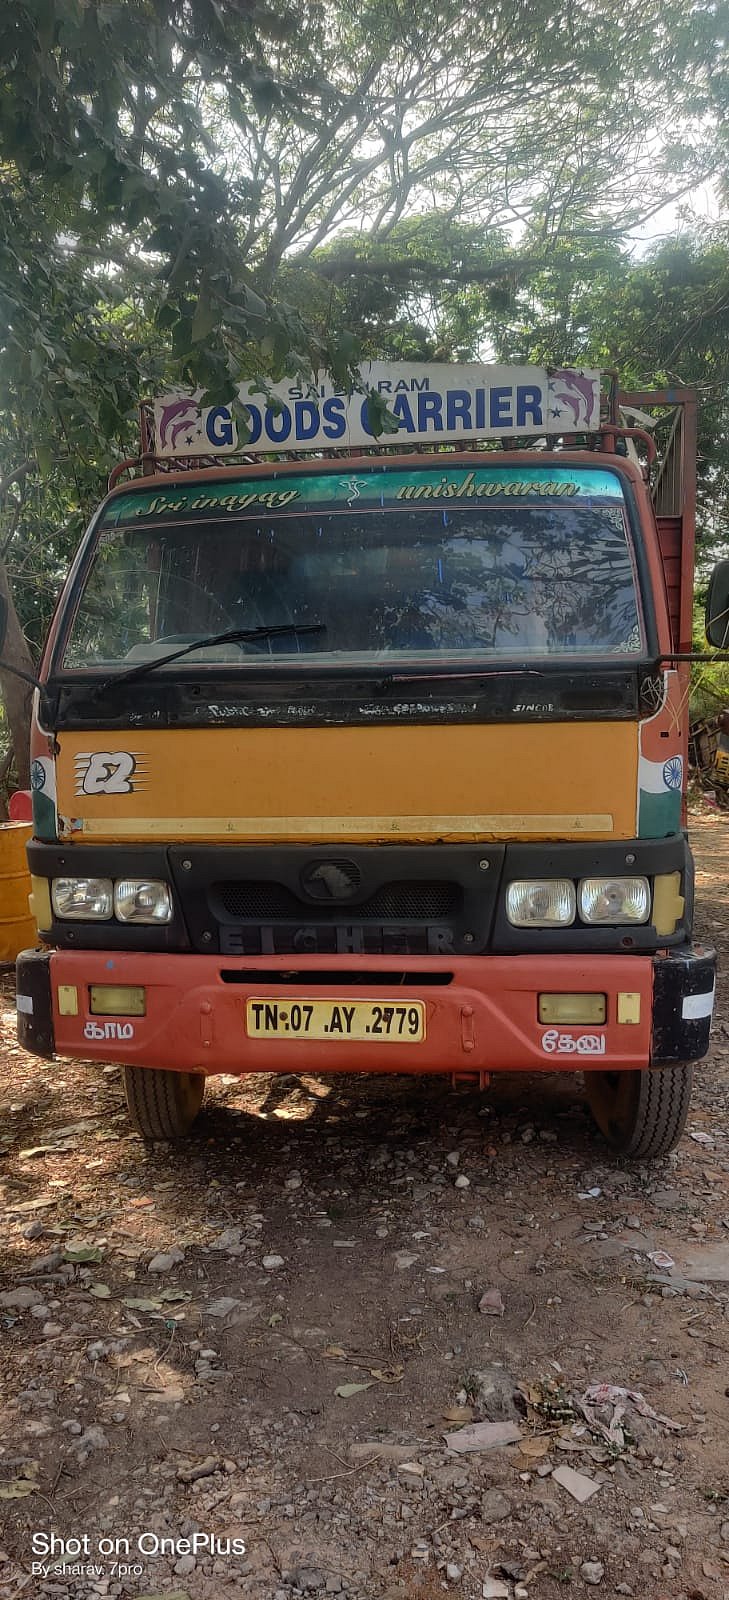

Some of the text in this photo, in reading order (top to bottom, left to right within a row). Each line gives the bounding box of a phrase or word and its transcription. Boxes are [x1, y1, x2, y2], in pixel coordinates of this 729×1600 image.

[288, 383, 325, 401] SAI
[377, 377, 430, 394] RAM
[206, 397, 346, 447] GOODS
[136, 496, 187, 516] Sri
